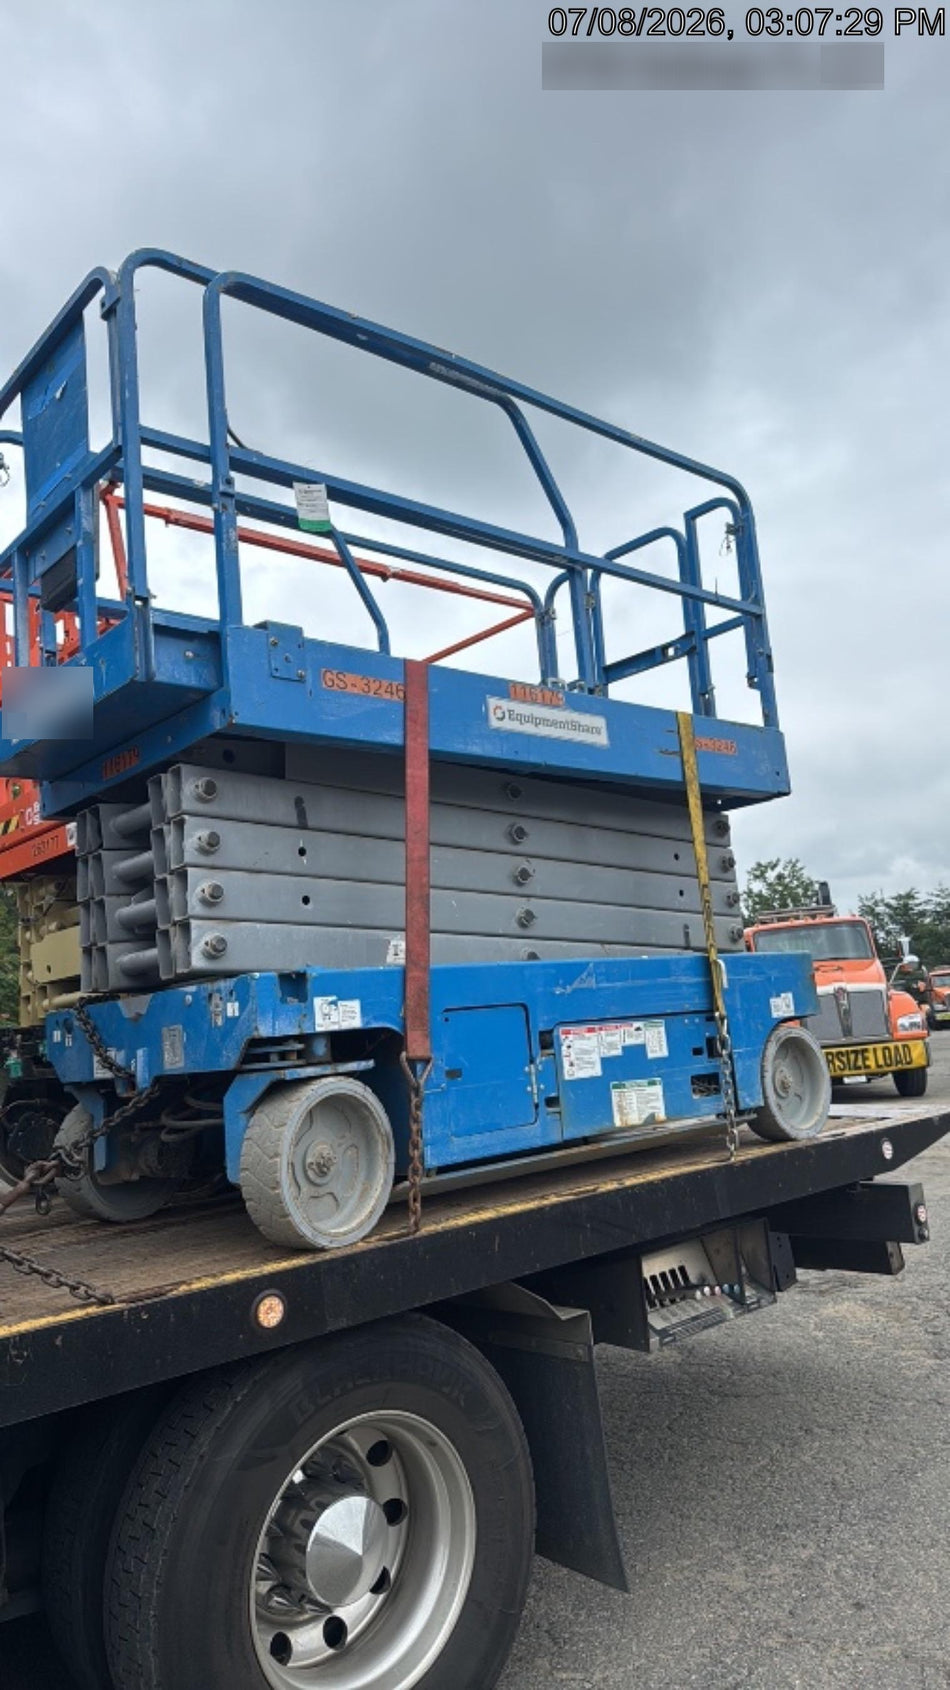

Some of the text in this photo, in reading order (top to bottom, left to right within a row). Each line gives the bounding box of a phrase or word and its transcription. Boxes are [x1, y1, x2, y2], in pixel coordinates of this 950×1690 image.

[322, 669, 405, 700] GS-3246
[506, 709, 603, 736] EquipmentShare
[872, 1044, 914, 1068] LOAD
